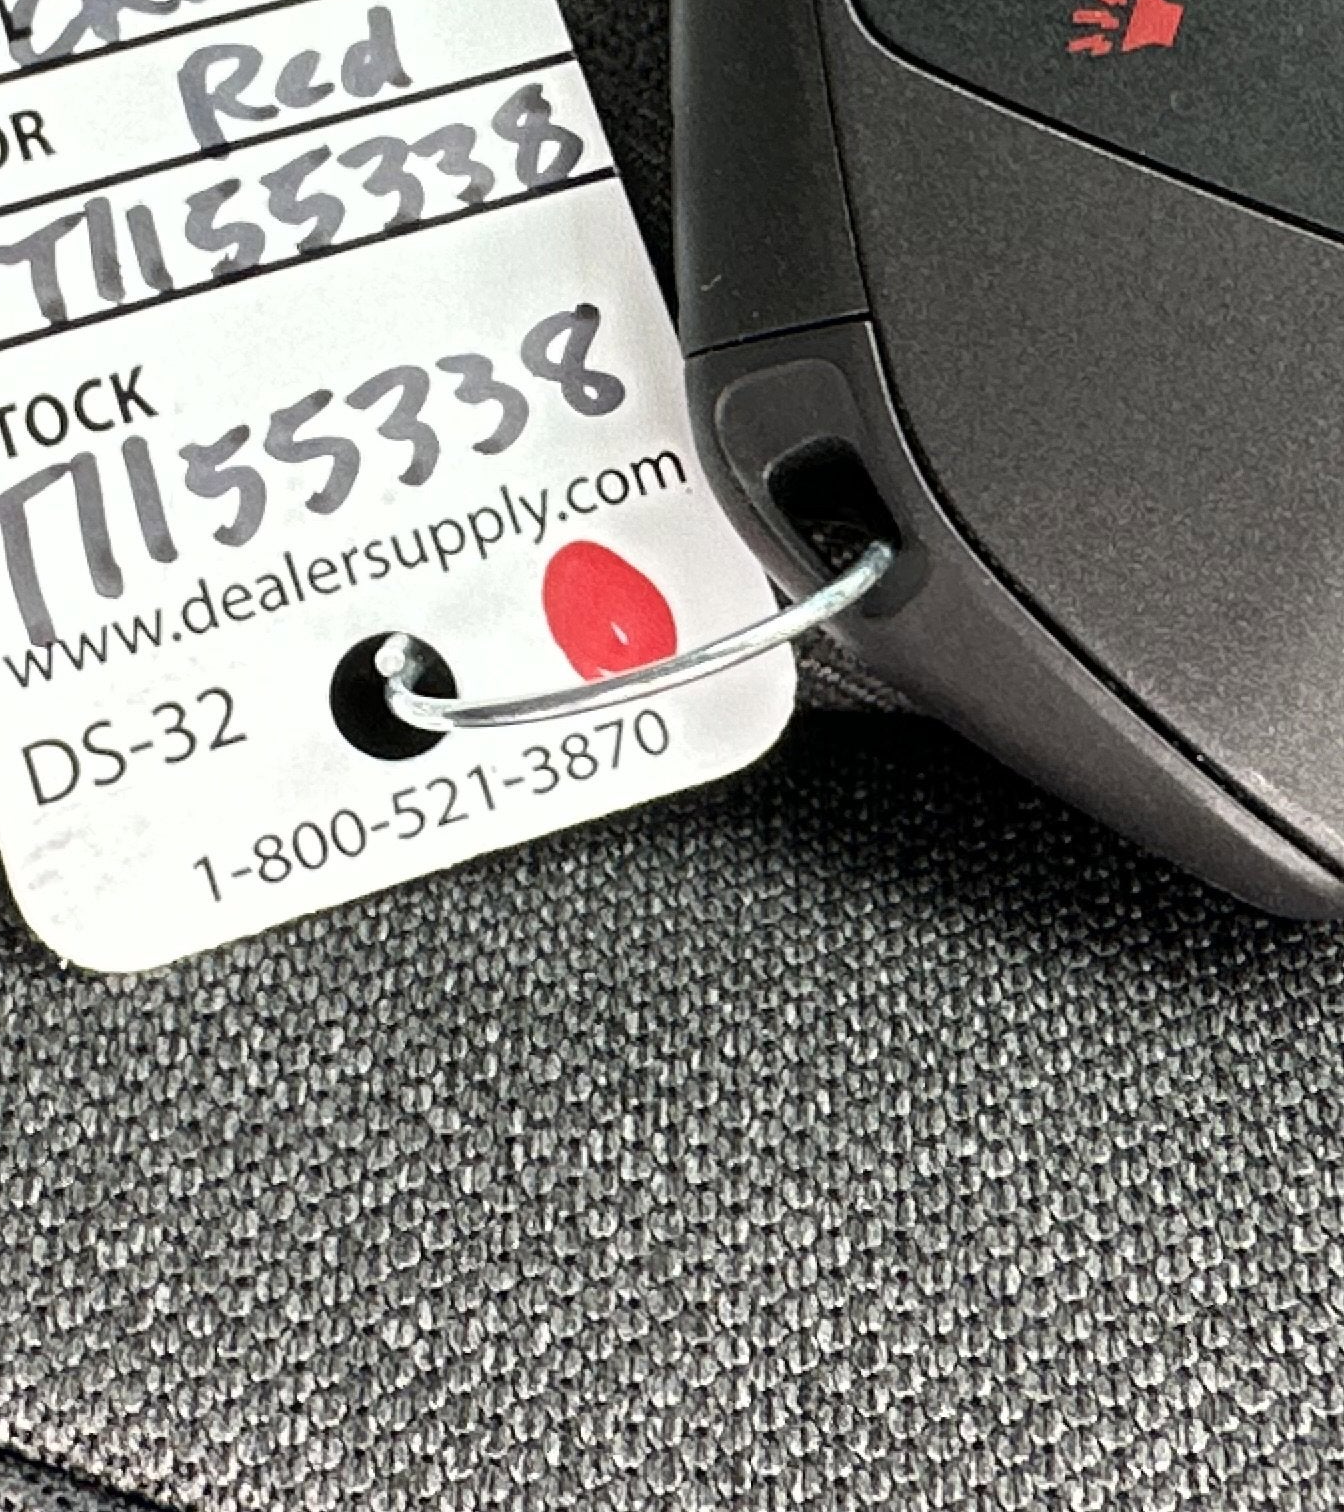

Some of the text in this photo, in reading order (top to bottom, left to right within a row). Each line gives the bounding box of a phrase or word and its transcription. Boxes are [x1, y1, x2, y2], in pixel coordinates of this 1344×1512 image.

[176, 5, 412, 157] Red
[4, 450, 687, 690] www.dealersupply.com
[20, 686, 247, 808] DS-32
[192, 709, 671, 904] 1-800-521-3870
